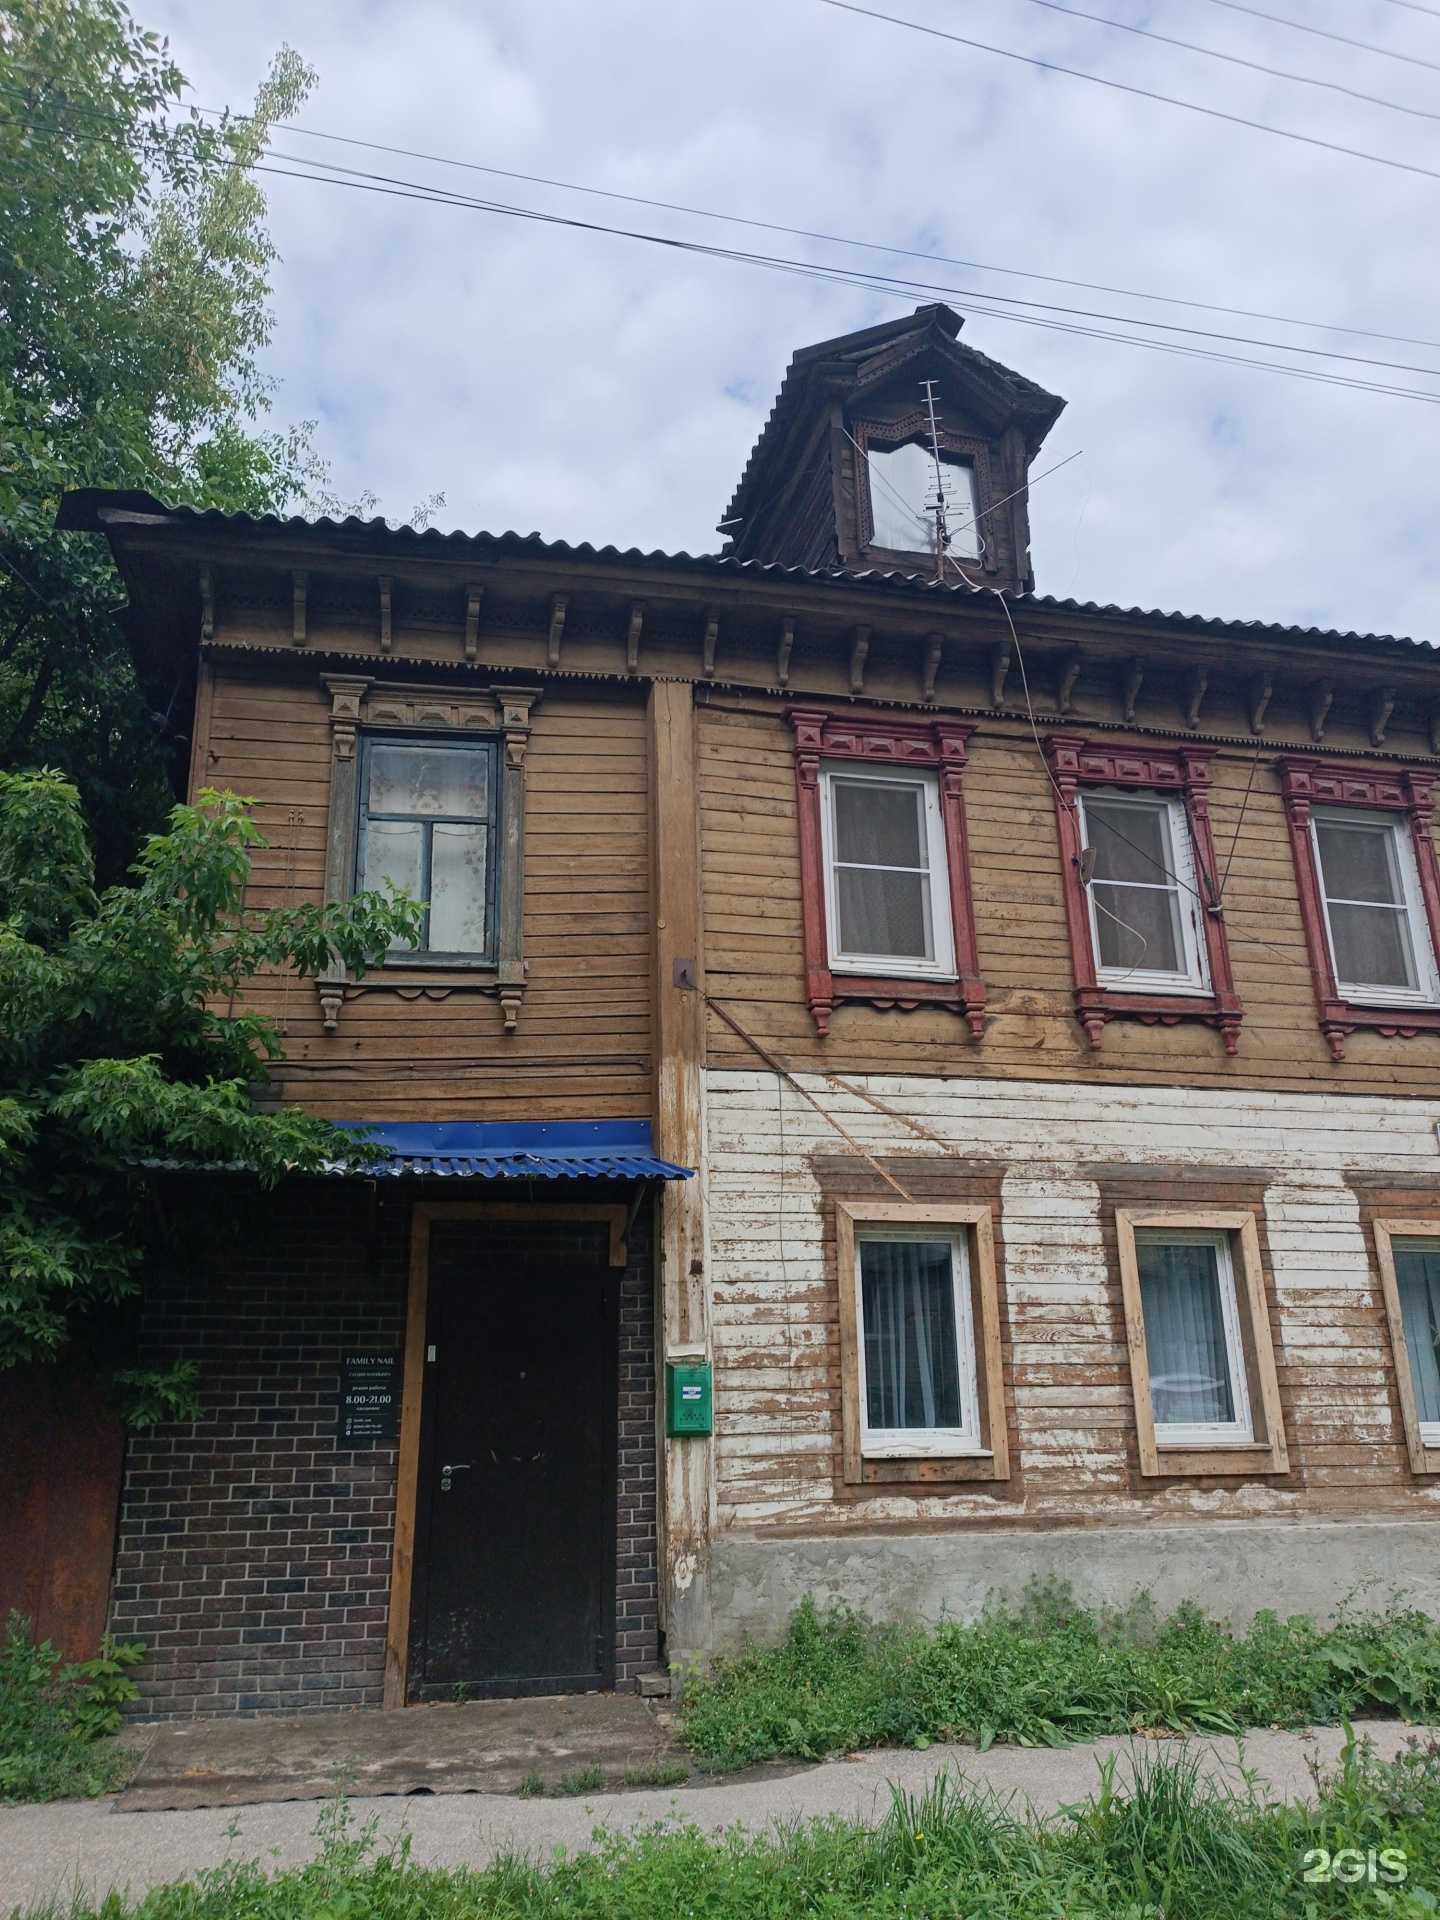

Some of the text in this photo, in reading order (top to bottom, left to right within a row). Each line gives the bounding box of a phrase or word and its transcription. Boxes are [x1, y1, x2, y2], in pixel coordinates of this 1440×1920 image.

[346, 1357, 394, 1365] FAMILY NAIL
[345, 1395, 392, 1404] 8.00-21.00
